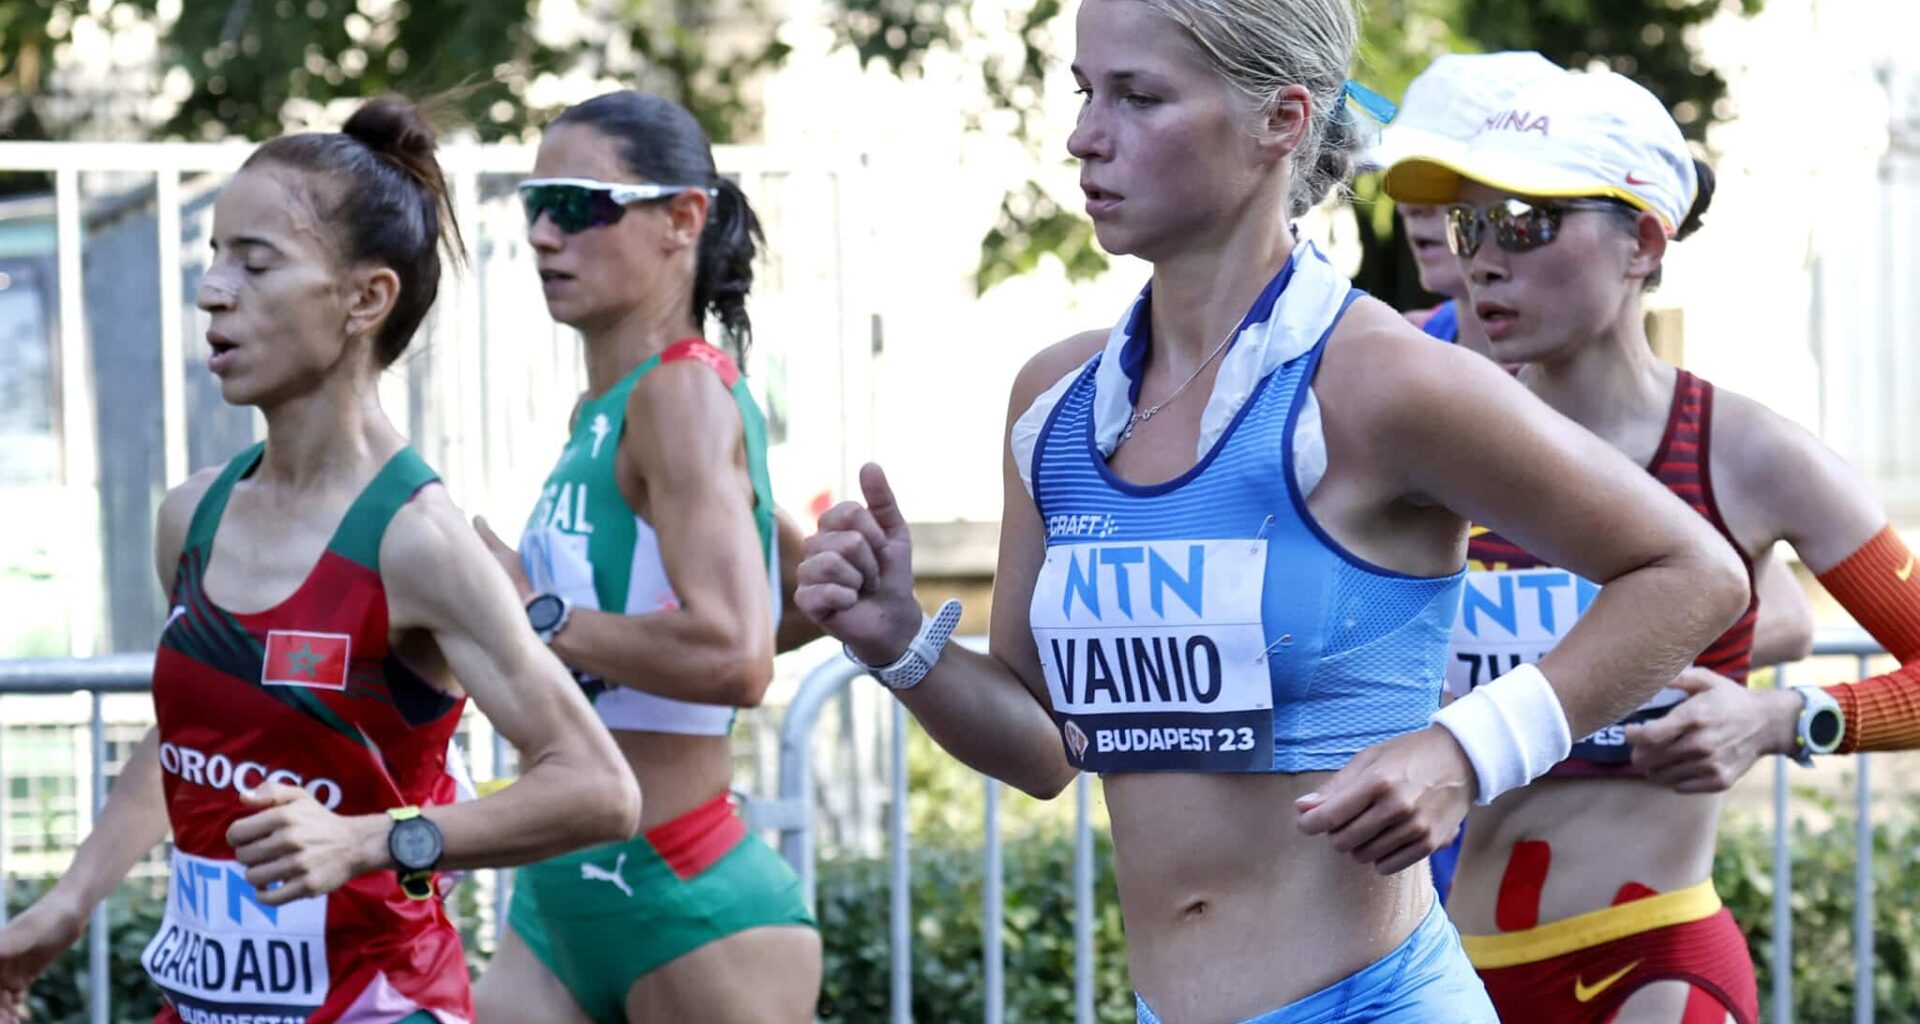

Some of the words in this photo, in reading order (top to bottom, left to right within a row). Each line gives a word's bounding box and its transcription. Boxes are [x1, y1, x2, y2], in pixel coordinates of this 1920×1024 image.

[1050, 515, 1102, 536] CRAFT
[1063, 545, 1204, 622] NTN
[1051, 634, 1222, 704] VAINIO
[1096, 728, 1213, 752] BUDAPEST
[1217, 727, 1255, 751] 23
[150, 925, 313, 995] GARDADI
